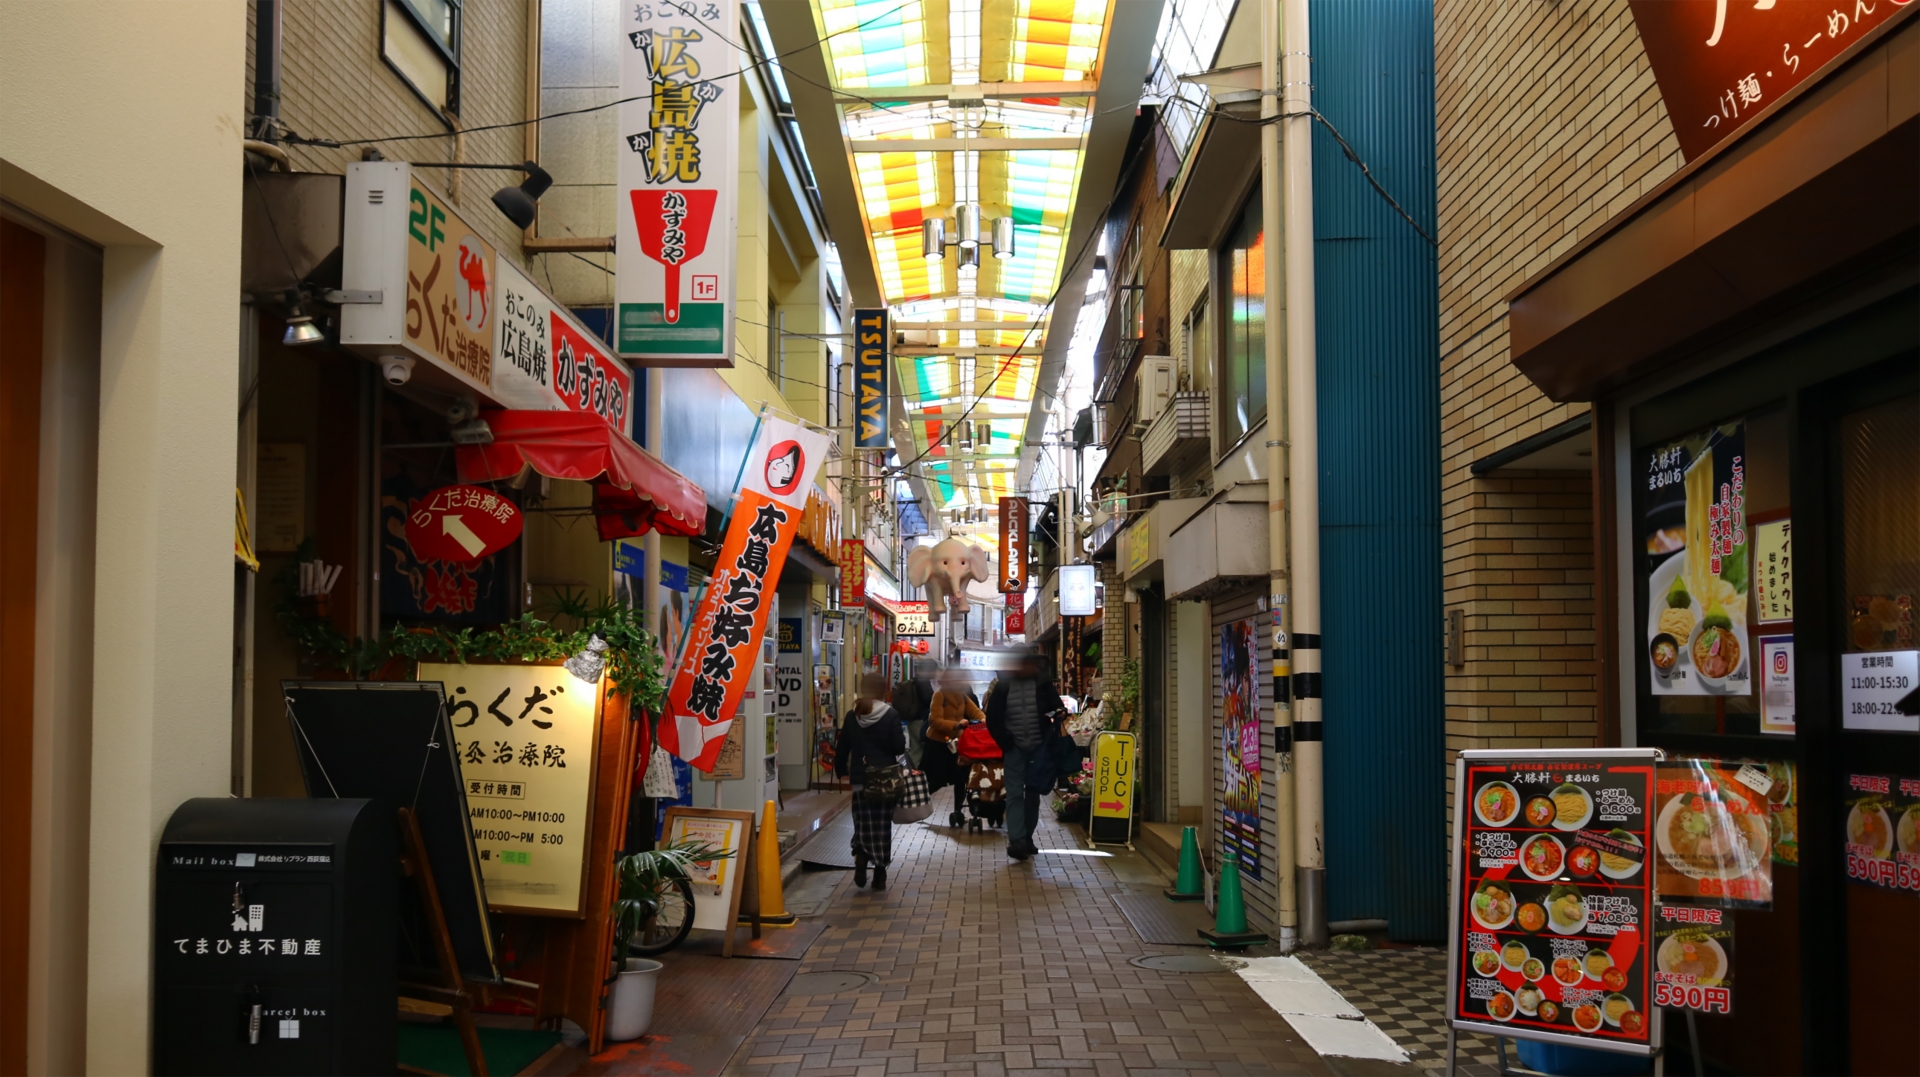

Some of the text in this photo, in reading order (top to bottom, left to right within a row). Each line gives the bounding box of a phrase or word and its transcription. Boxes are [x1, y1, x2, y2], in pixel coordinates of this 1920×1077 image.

[647, 26, 703, 185] 広島焼
[408, 187, 446, 253] 2F
[661, 191, 687, 264] かずみや
[697, 281, 714, 296] 1F
[505, 288, 546, 340] おこのみ
[455, 331, 491, 388] 治療院
[500, 318, 547, 387] 広島焼
[557, 334, 623, 432] かずみや
[860, 315, 882, 442] TSUTAYA
[1648, 445, 1682, 474] 大勝軒
[1648, 467, 1682, 490] まるいち
[411, 487, 515, 527] らくだ治療院
[1720, 483, 1733, 556] 自家製麺
[1731, 455, 1745, 546] こだわりの
[1007, 499, 1020, 580] AUCKLAND
[1708, 504, 1721, 576] 極み太麺
[852, 542, 863, 586] カラオケ
[1768, 551, 1779, 613] 始めました
[1780, 523, 1791, 617] テイクアウト
[685, 501, 788, 723] 広島お好み焼
[892, 654, 901, 686] 恵方
[1861, 656, 1894, 669] 営業時間
[1850, 675, 1909, 690] 11:00-15:30
[448, 685, 566, 730] らくだ
[470, 782, 521, 797] 受付時間
[1100, 756, 1109, 795] SHOP
[1511, 772, 1600, 784] 大勝軒 まるいち
[1850, 774, 1890, 794] 平日限定
[541, 833, 564, 845] 5:00
[173, 856, 234, 866] Mail box
[1847, 854, 1897, 888] 590円
[1698, 877, 1760, 900] 850円
[1661, 907, 1723, 925] 平日限定
[173, 938, 322, 956] てまひま不動産
[1655, 971, 1697, 985] まぜそば
[303, 1008, 327, 1017] box
[1655, 984, 1730, 1013] 590円
